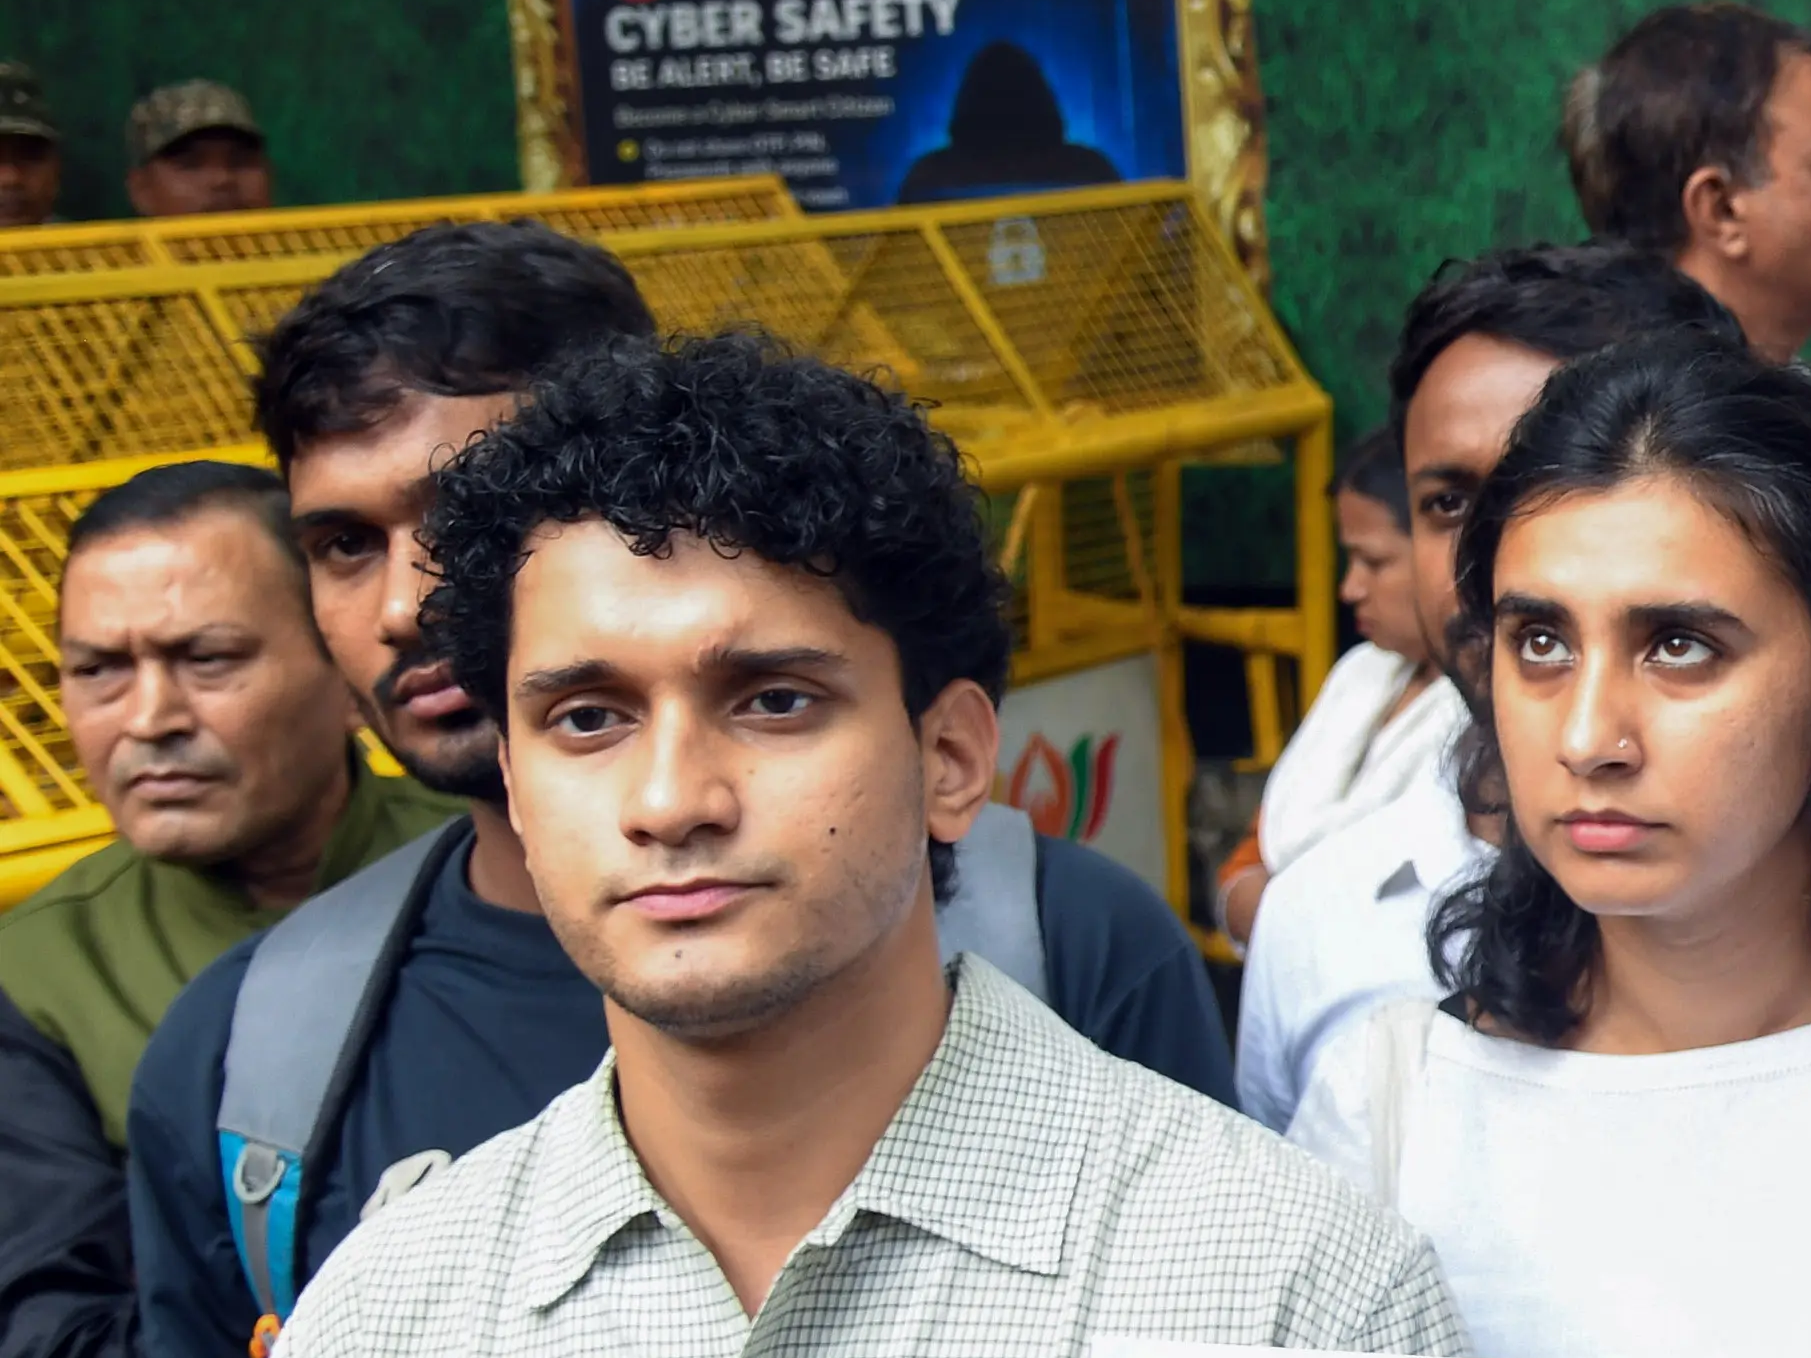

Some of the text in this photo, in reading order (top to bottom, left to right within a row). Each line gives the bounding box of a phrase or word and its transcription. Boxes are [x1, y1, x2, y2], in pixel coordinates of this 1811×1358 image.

[610, 45, 897, 91] BE ALERT, BE SAFE
